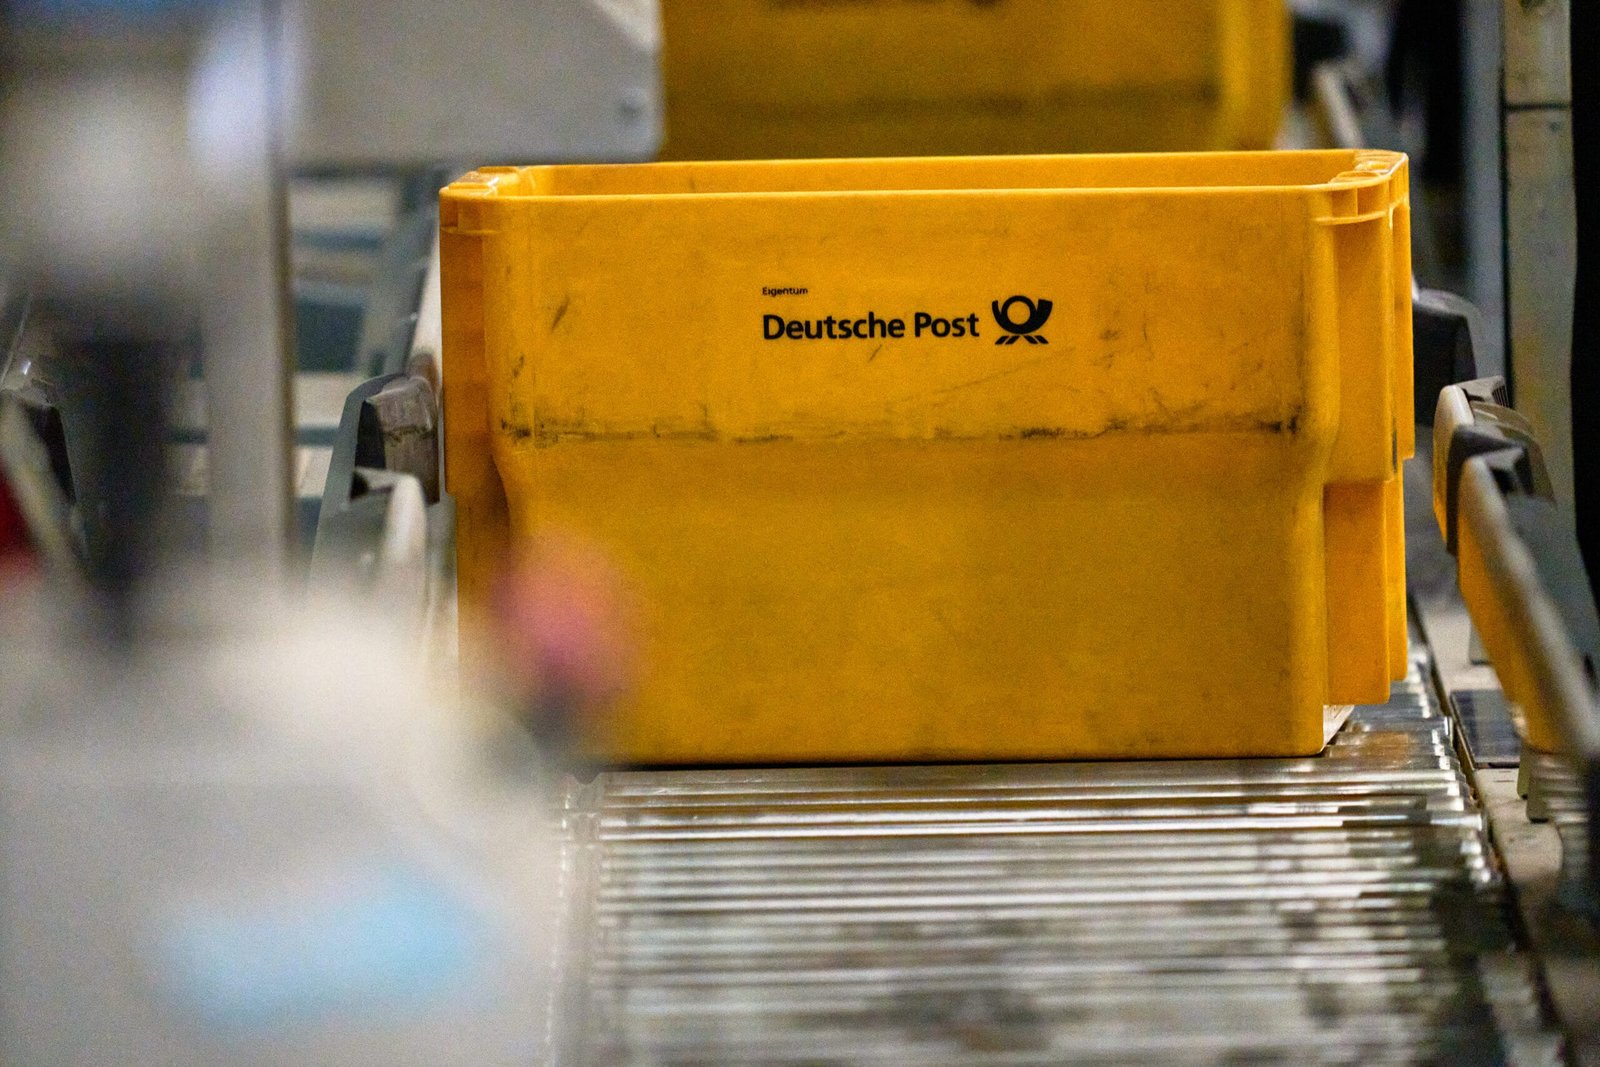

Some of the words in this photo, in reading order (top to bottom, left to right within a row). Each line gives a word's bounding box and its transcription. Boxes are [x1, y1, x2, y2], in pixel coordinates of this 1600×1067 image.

[762, 286, 808, 297] Eigentum
[763, 311, 905, 340] Deutsche
[914, 312, 980, 338] Post
